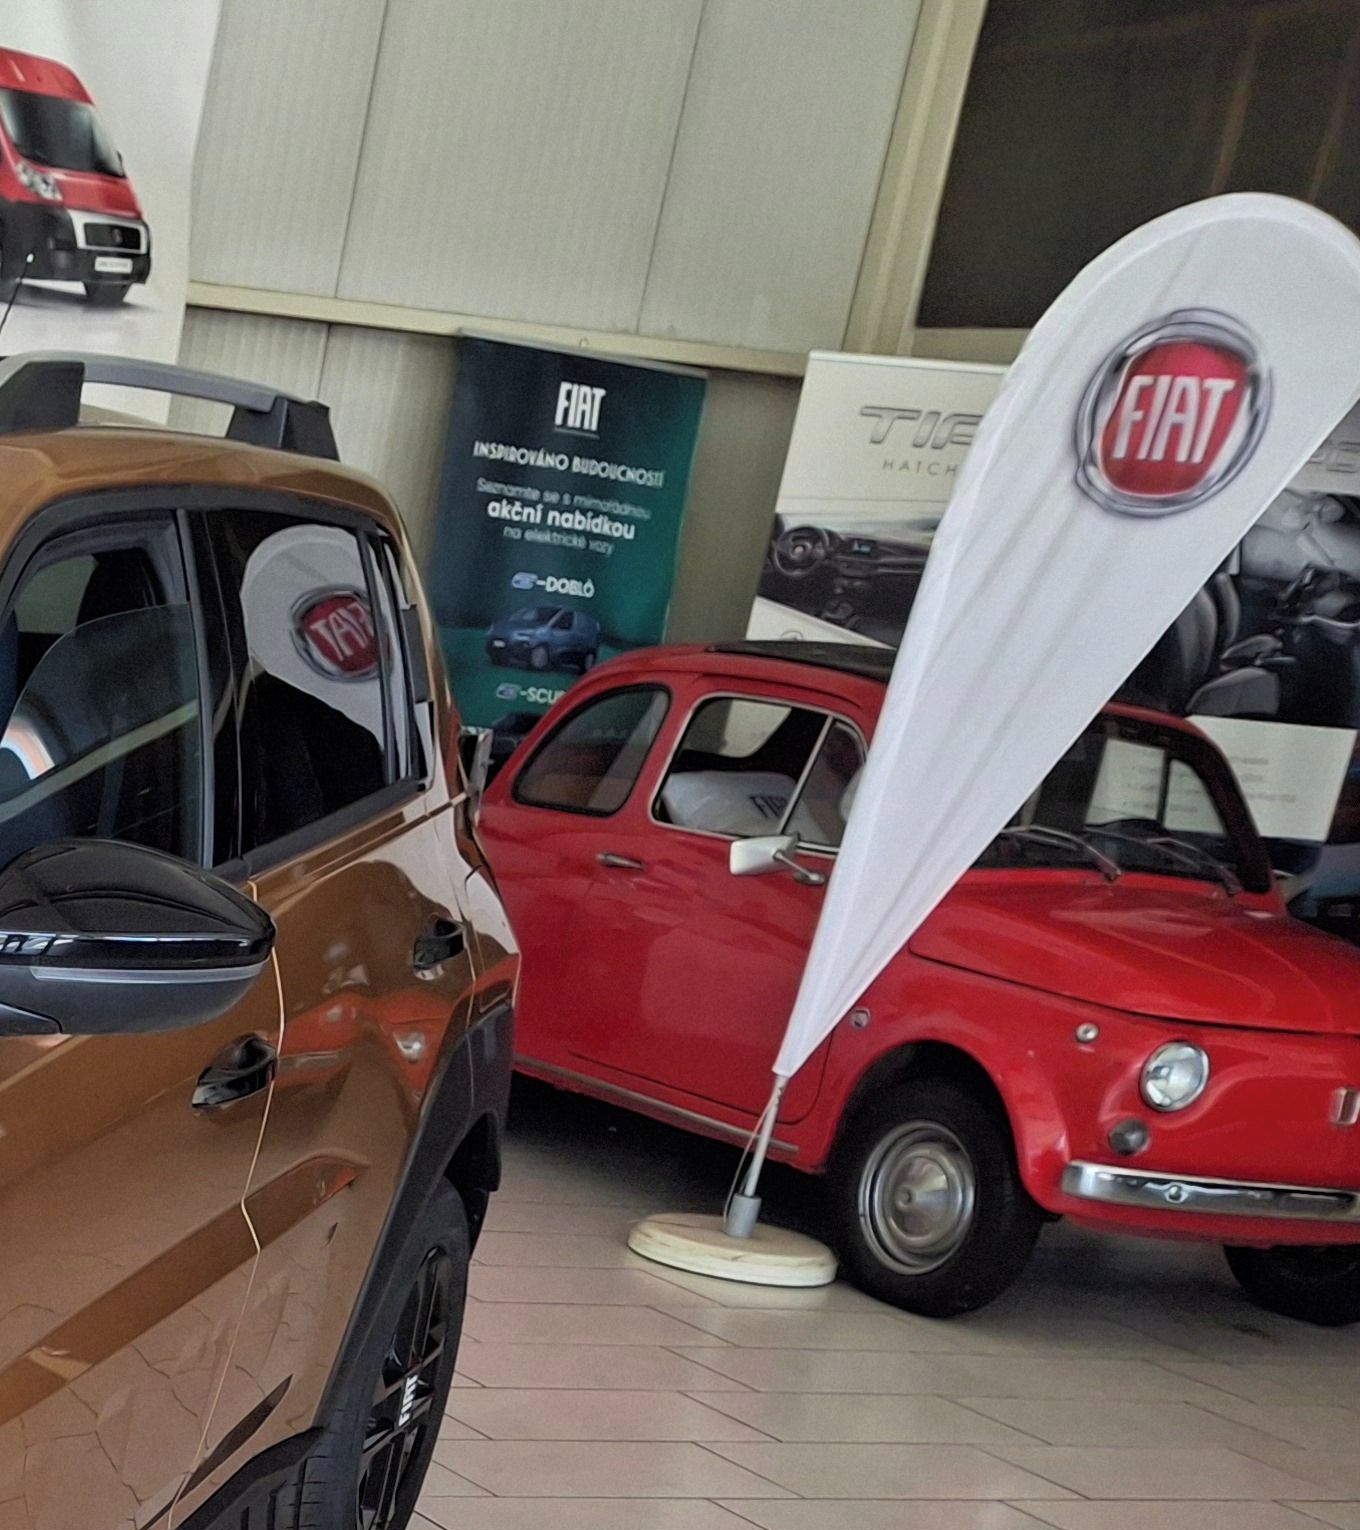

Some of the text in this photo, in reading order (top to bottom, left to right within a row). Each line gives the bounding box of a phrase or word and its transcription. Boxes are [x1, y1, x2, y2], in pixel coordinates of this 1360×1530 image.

[554, 381, 606, 431] FIAT
[1113, 374, 1236, 463] FIAT
[473, 440, 569, 471] INSPIROVÁNO
[487, 498, 636, 540] akční nabídkou
[503, 526, 522, 540] na
